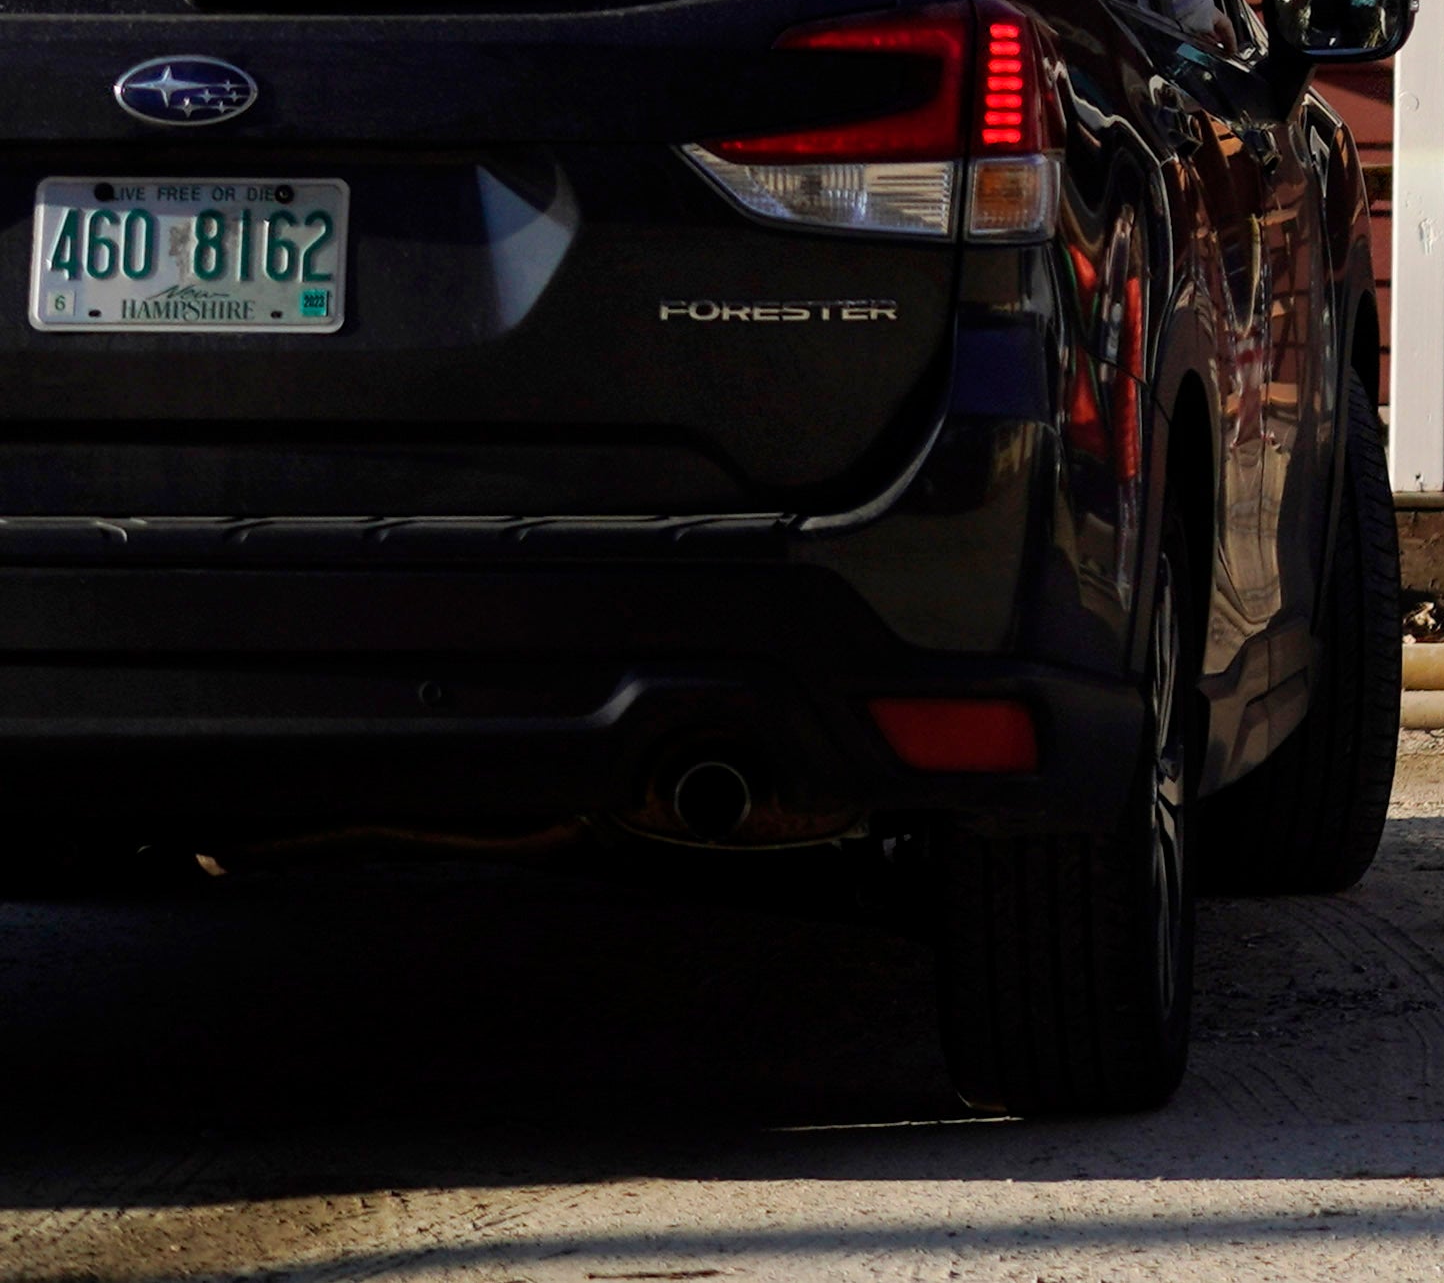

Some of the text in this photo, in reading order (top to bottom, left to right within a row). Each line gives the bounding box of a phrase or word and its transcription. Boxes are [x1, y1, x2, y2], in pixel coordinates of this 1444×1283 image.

[157, 186, 200, 202] FREE
[212, 186, 237, 202] OR
[246, 187, 276, 202] DIE
[48, 208, 335, 284] 460 8162
[54, 295, 67, 312] 6
[121, 299, 257, 322] HAMPSHIRE
[658, 299, 899, 321] FORESTER
